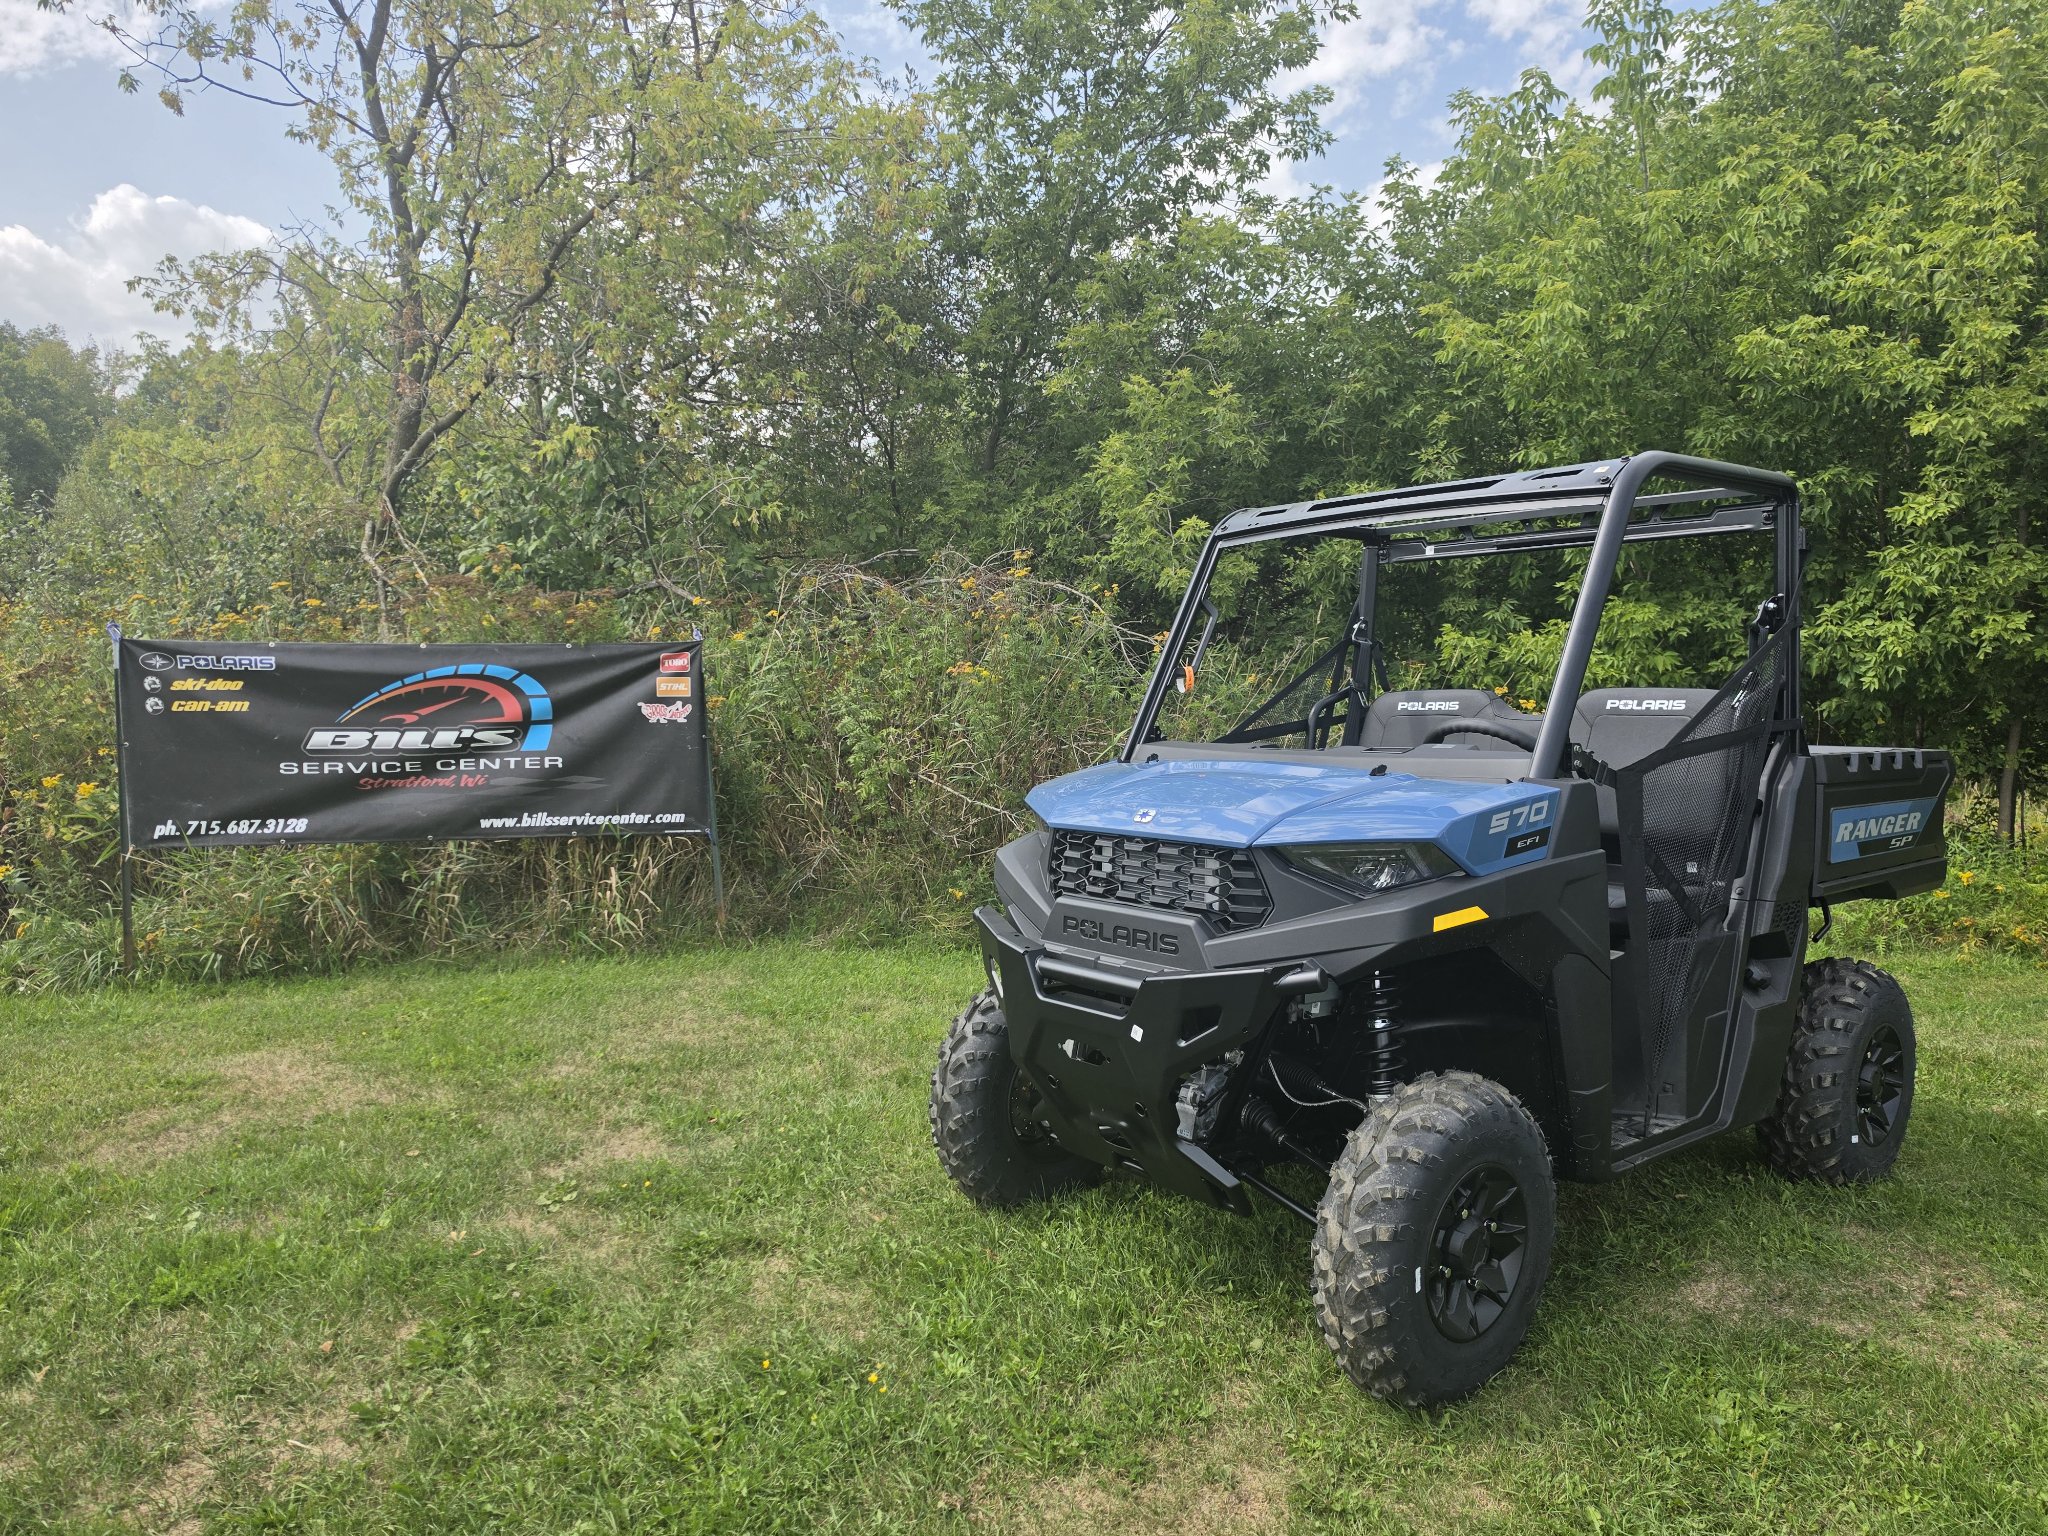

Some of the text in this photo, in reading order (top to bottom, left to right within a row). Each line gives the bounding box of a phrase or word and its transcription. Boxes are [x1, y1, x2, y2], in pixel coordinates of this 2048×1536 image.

[177, 655, 275, 670] POLARIS
[664, 658, 688, 667] TORO
[170, 678, 244, 690] ski-doo
[659, 683, 688, 691] STIHL
[171, 700, 250, 712] can-am
[1397, 701, 1459, 711] POLARIS
[1606, 699, 1686, 711] POLARIS
[279, 756, 563, 774] SERVICE CENTER
[460, 774, 488, 788] Wi
[480, 812, 685, 828] www.billsservicecenter.com
[1488, 800, 1549, 835] 570
[154, 818, 308, 839] ph. 715.687.3128
[1835, 812, 1921, 843] RANGER
[1516, 835, 1540, 849] EFI
[1889, 835, 1913, 849] SP
[1063, 915, 1180, 955] POLARIS
